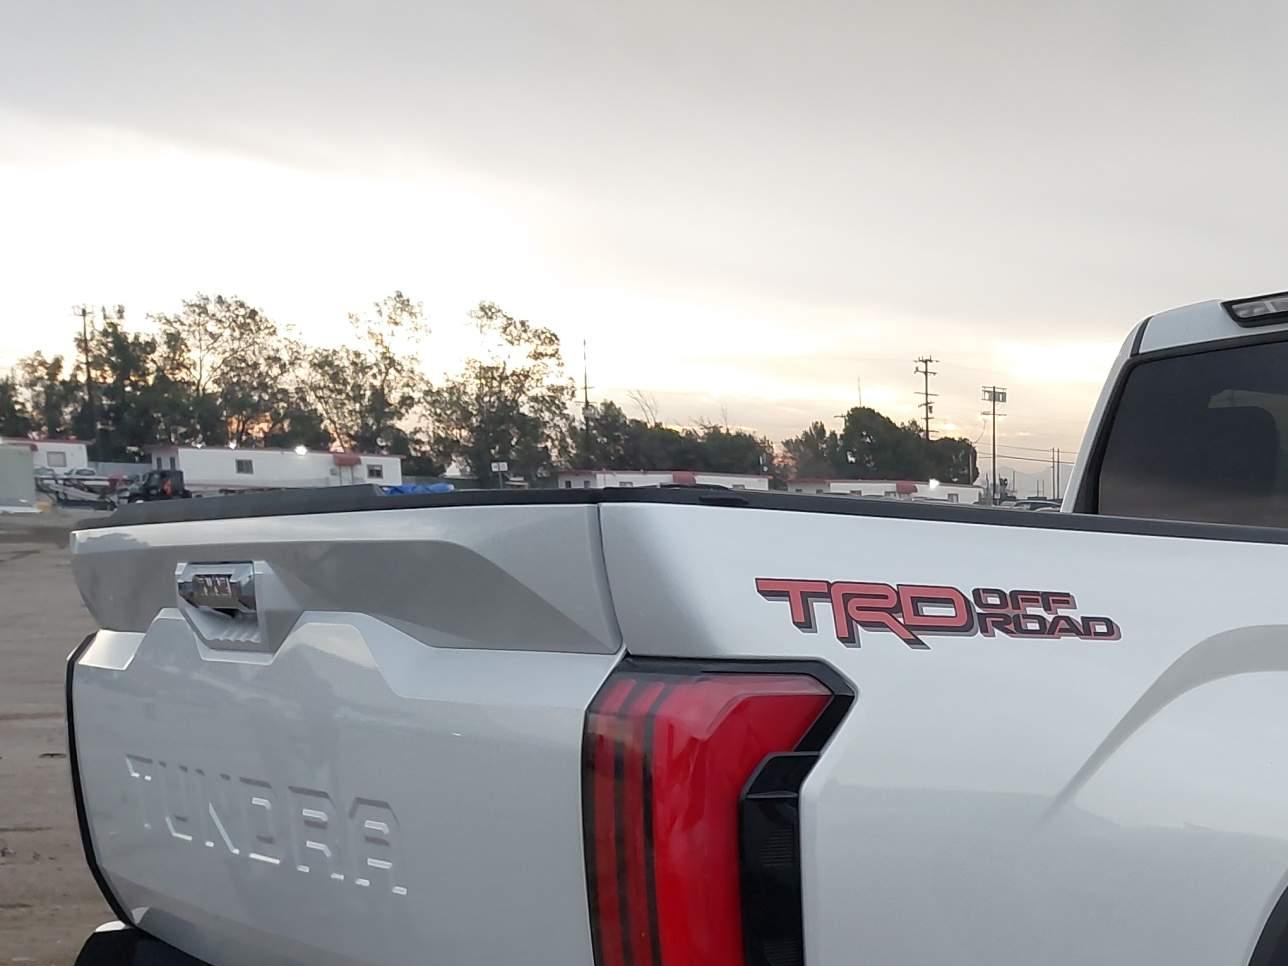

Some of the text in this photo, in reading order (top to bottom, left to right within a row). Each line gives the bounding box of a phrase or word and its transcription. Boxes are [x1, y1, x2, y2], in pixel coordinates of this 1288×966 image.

[754, 577, 979, 650] TRD
[971, 587, 1077, 614] OFF
[976, 612, 1122, 641] ROAD
[126, 753, 408, 896] TUNDRA
